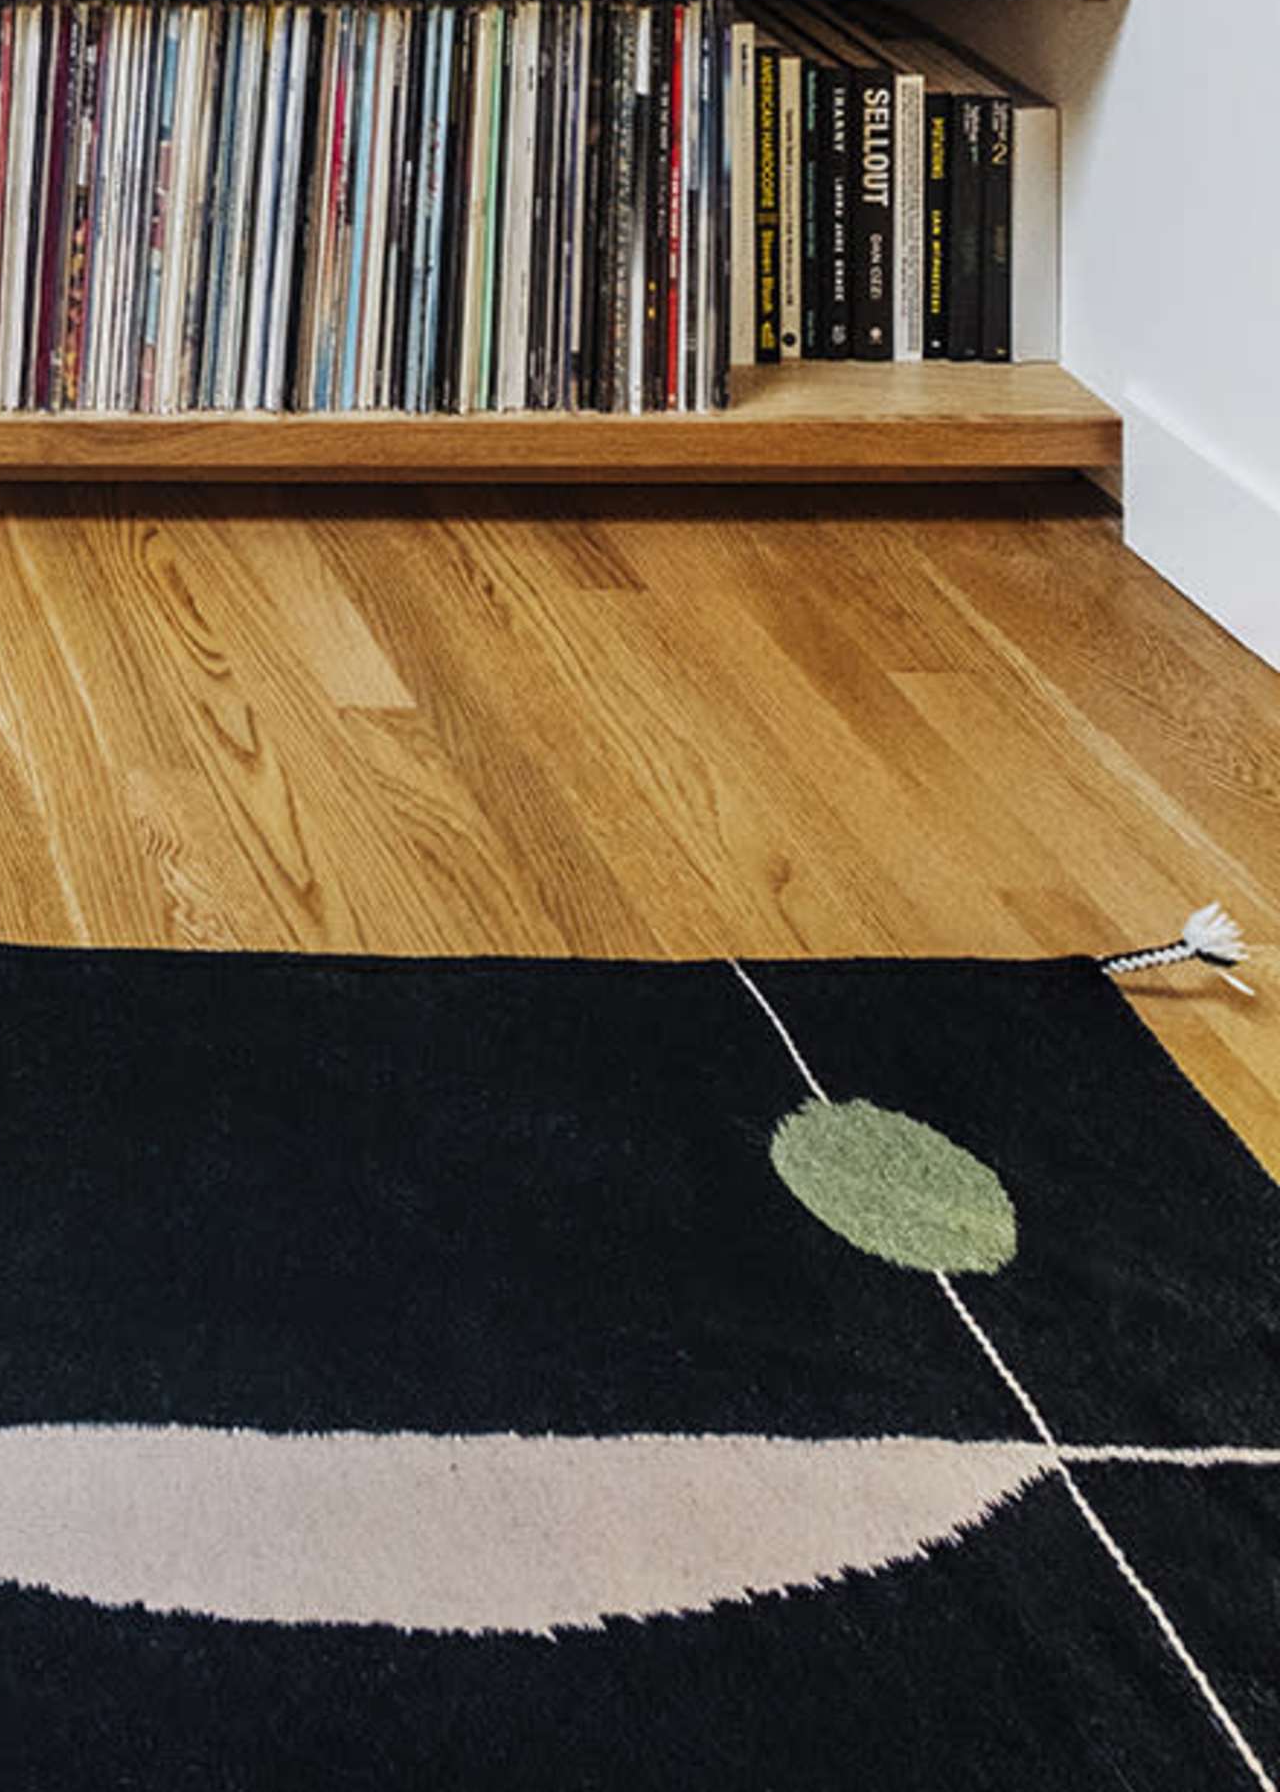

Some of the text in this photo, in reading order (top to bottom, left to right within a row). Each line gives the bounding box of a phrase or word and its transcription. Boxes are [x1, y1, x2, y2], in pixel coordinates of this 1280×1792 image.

[760, 55, 775, 130] AMERICAN
[760, 132, 775, 208] HARDCORE
[862, 88, 890, 207] SELLOUT
[868, 233, 883, 264] DAN
